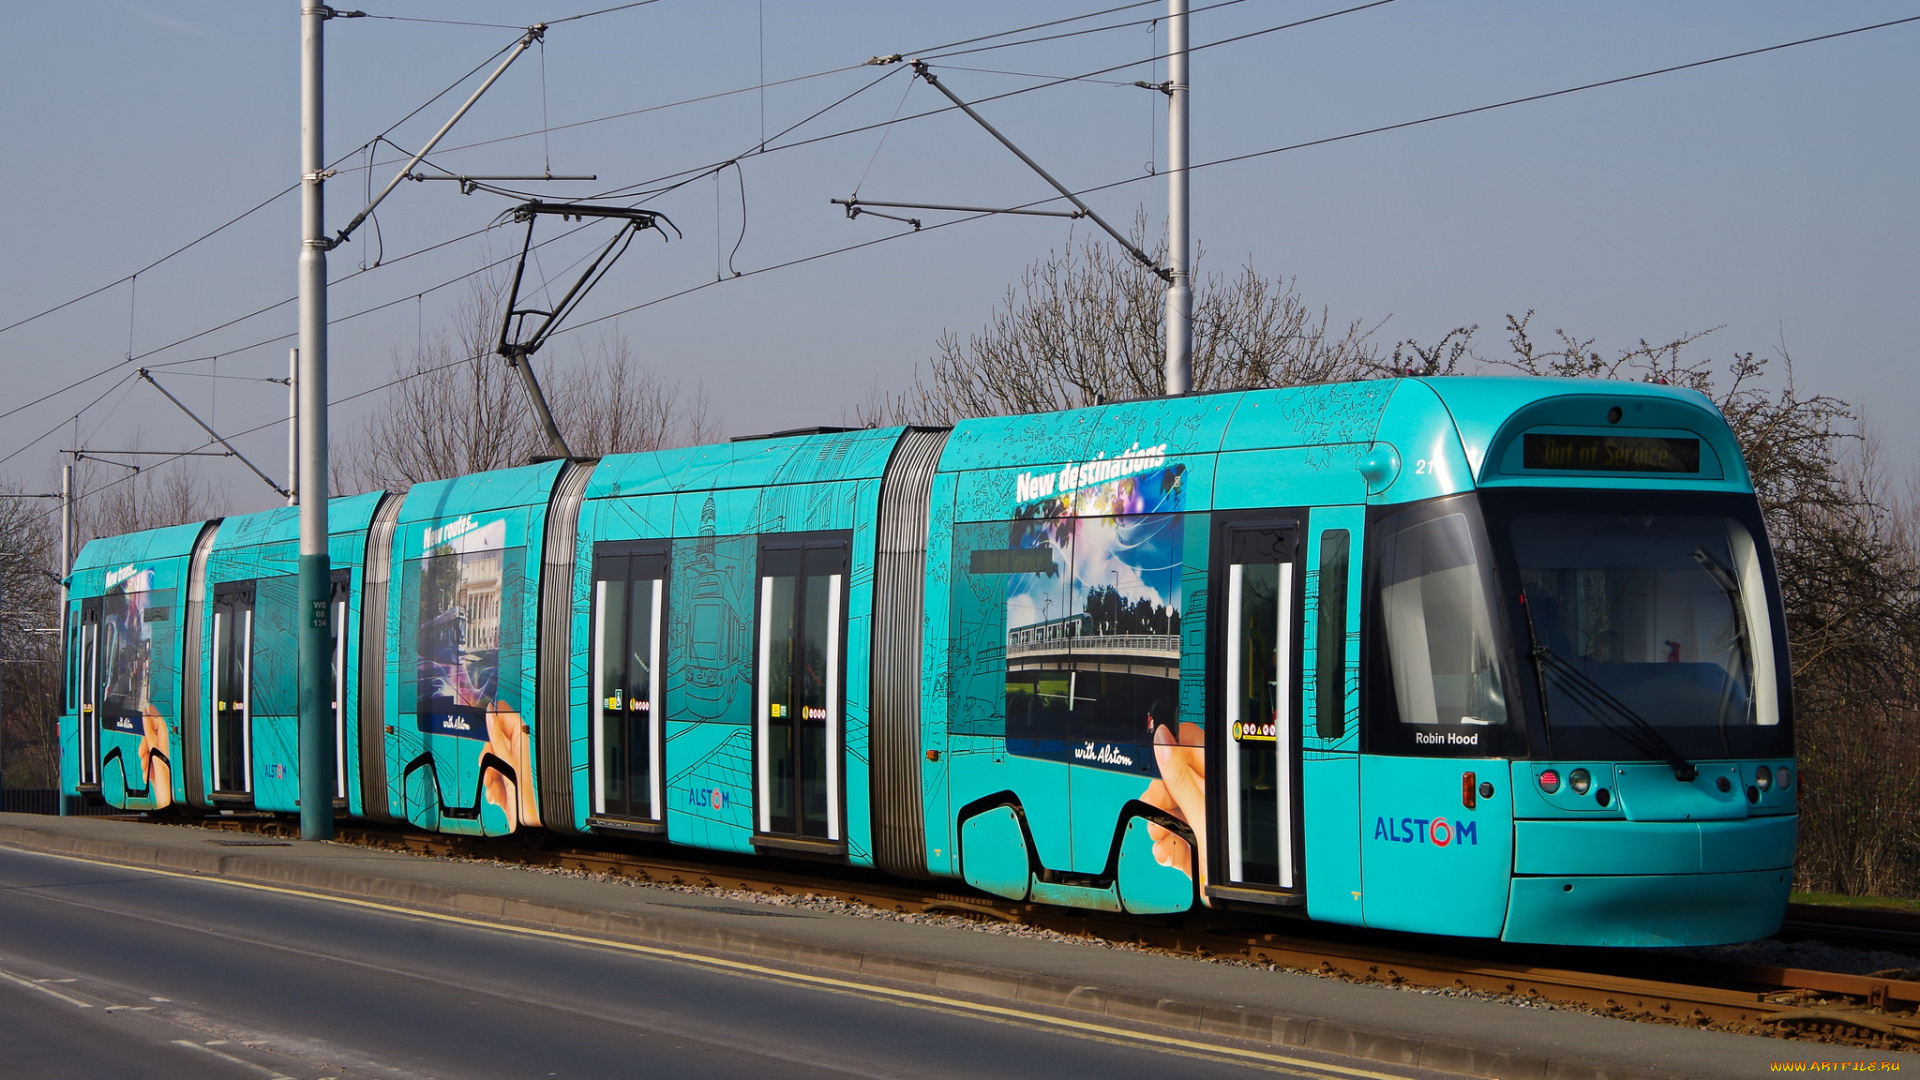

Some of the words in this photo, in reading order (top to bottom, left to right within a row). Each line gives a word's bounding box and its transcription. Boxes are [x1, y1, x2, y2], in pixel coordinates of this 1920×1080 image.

[1544, 438, 1573, 465] Out
[1580, 441, 1599, 466] of
[1604, 440, 1669, 467] Service
[1016, 471, 1056, 503] New
[1058, 442, 1167, 492] destinations
[423, 527, 443, 549] New
[1415, 732, 1445, 744] Robin
[1447, 732, 1478, 745] Hood
[1075, 741, 1097, 760] with
[1097, 744, 1133, 766] Alstom
[265, 763, 287, 779] ALSTOM
[689, 787, 730, 810] ALSTOM
[1374, 816, 1477, 847] ALSTOM
